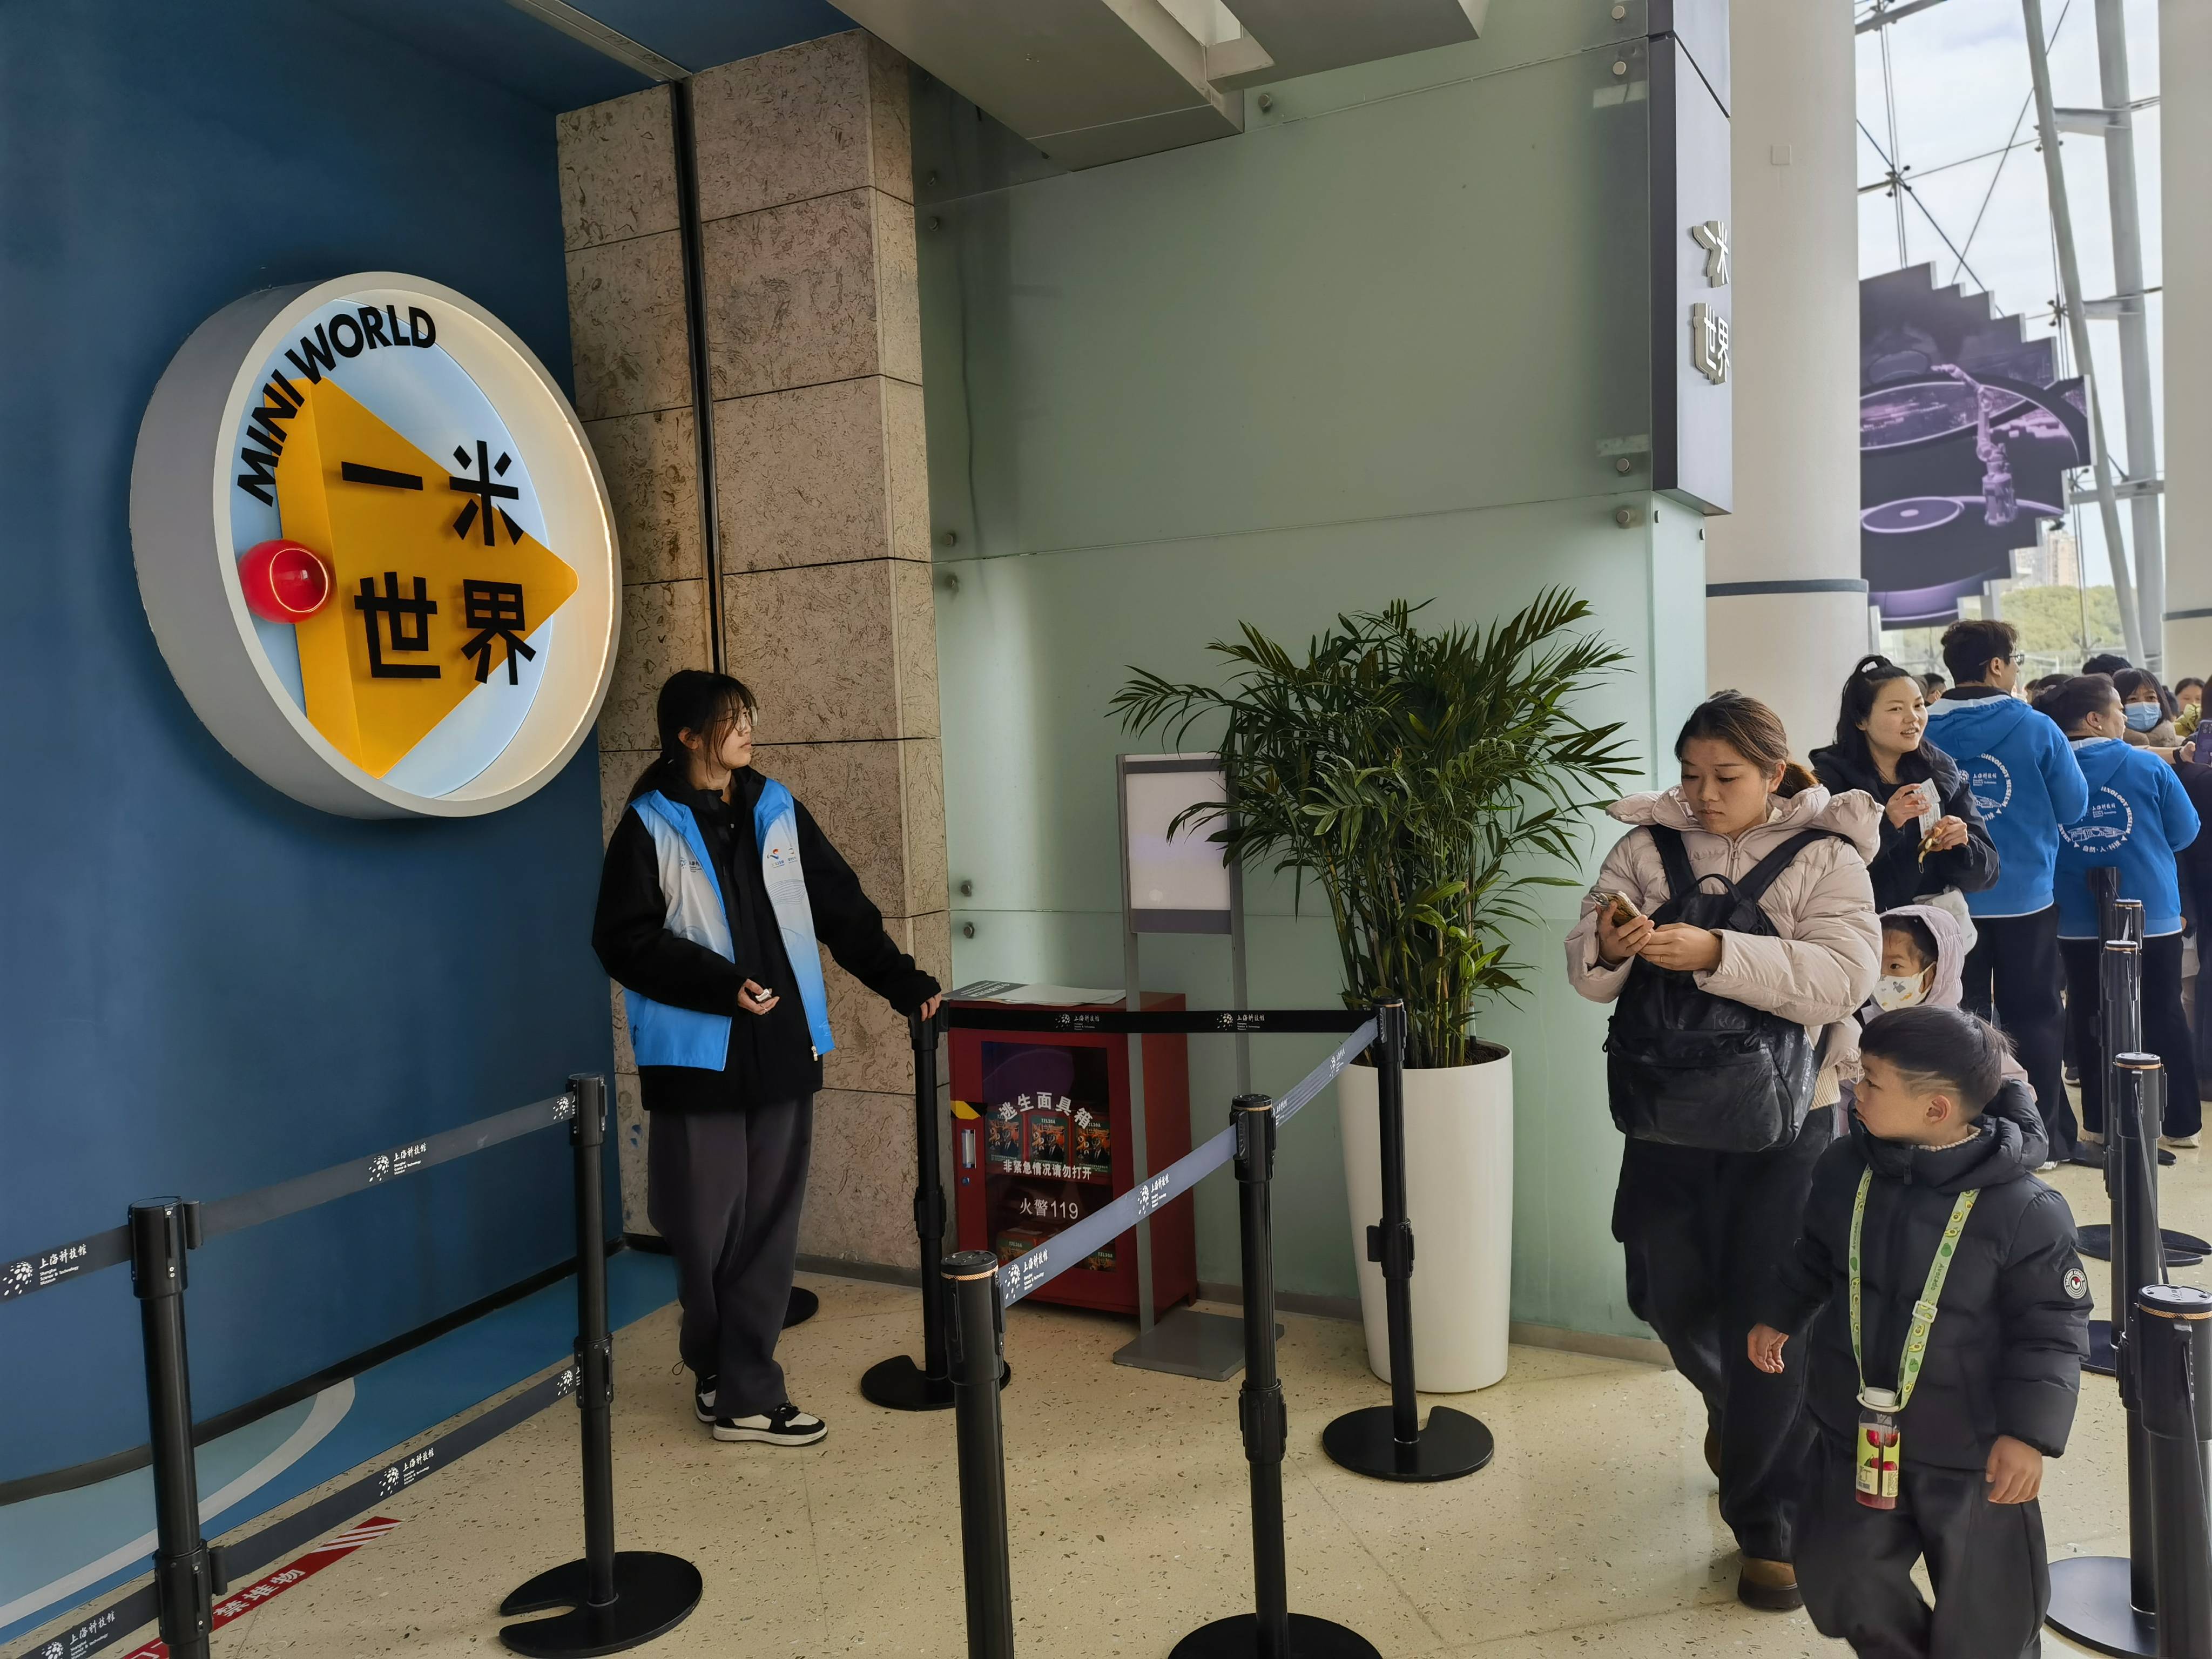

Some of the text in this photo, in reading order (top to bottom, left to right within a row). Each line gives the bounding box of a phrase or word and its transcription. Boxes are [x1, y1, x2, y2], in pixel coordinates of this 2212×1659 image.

[1701, 302, 1730, 383] 世界
[237, 305, 436, 507] MINI WORLD
[341, 440, 524, 546] 一米
[354, 572, 536, 685] 世界
[999, 1091, 1093, 1130] 逃生面具箱
[394, 1142, 427, 1162] 上海科技馆
[1003, 1159, 1092, 1181] 非紧急情况请勿打开
[1020, 1198, 1078, 1219] 火警119
[39, 1244, 87, 1269] 上海科技馆
[1931, 1263, 1945, 1291] Avocado
[403, 1447, 435, 1472] 上海科技馆
[70, 1610, 115, 1645] 上海科技馆
